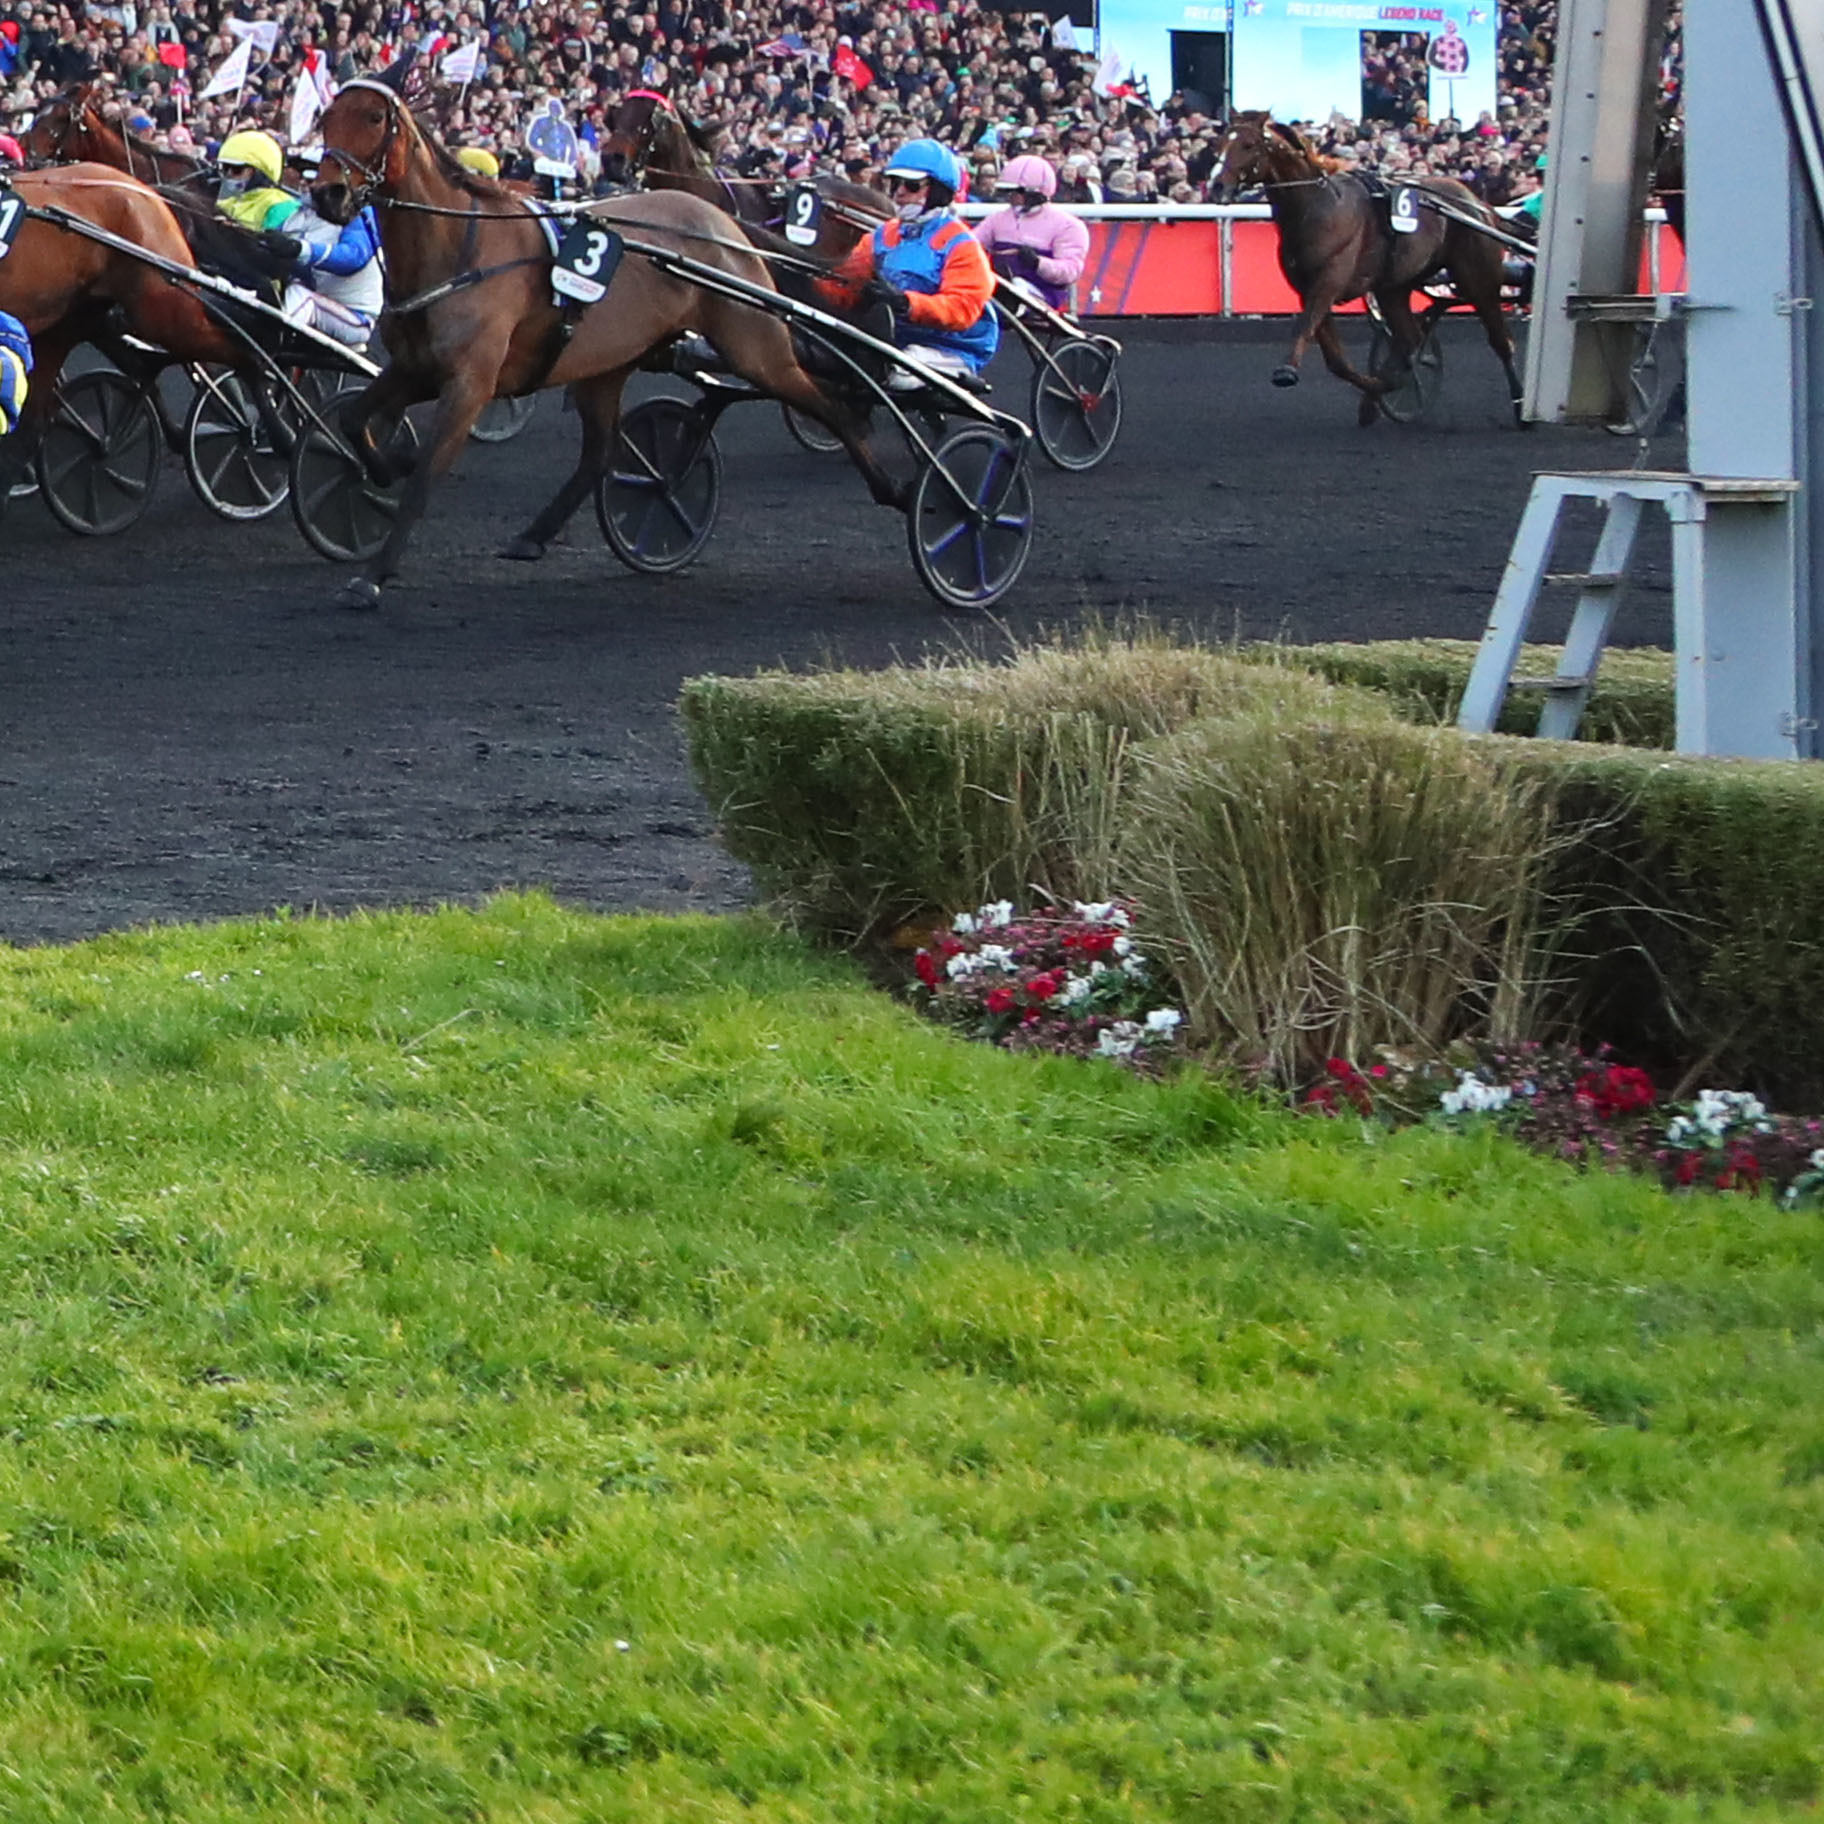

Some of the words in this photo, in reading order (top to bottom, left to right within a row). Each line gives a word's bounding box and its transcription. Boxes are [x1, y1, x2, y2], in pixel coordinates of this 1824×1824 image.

[797, 192, 813, 226] 9
[1398, 188, 1411, 217] 6
[573, 230, 608, 277] 3
